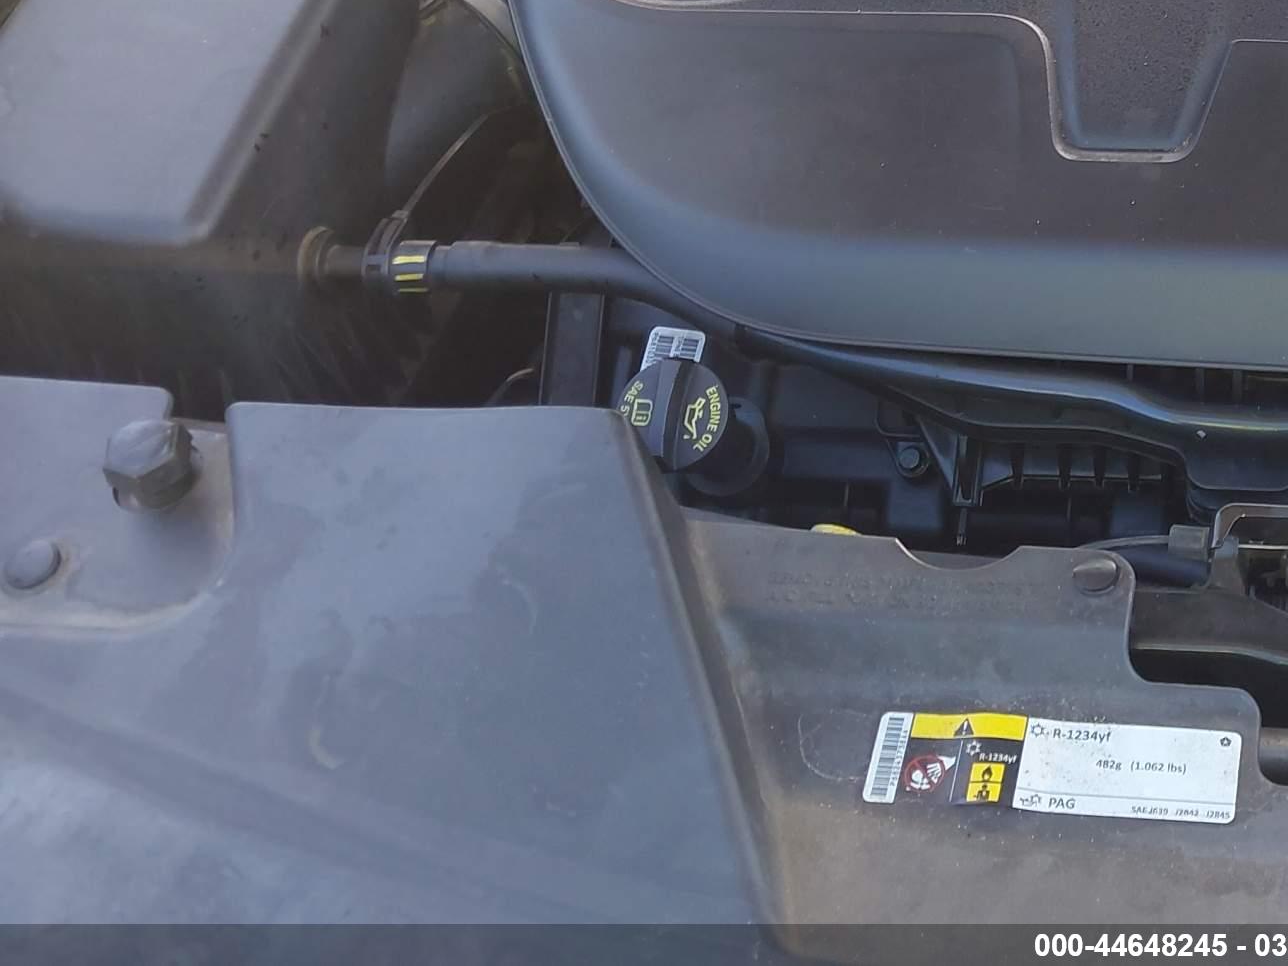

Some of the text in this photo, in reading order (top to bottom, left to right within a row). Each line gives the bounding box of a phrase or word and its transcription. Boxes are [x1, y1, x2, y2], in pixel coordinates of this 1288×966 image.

[624, 380, 644, 403] SAE
[693, 385, 721, 452] ENGINE OIL
[1053, 729, 1112, 744] R-1234yf
[1096, 760, 1187, 775] 482g (1.062 lbs)
[1048, 797, 1076, 809] PAG
